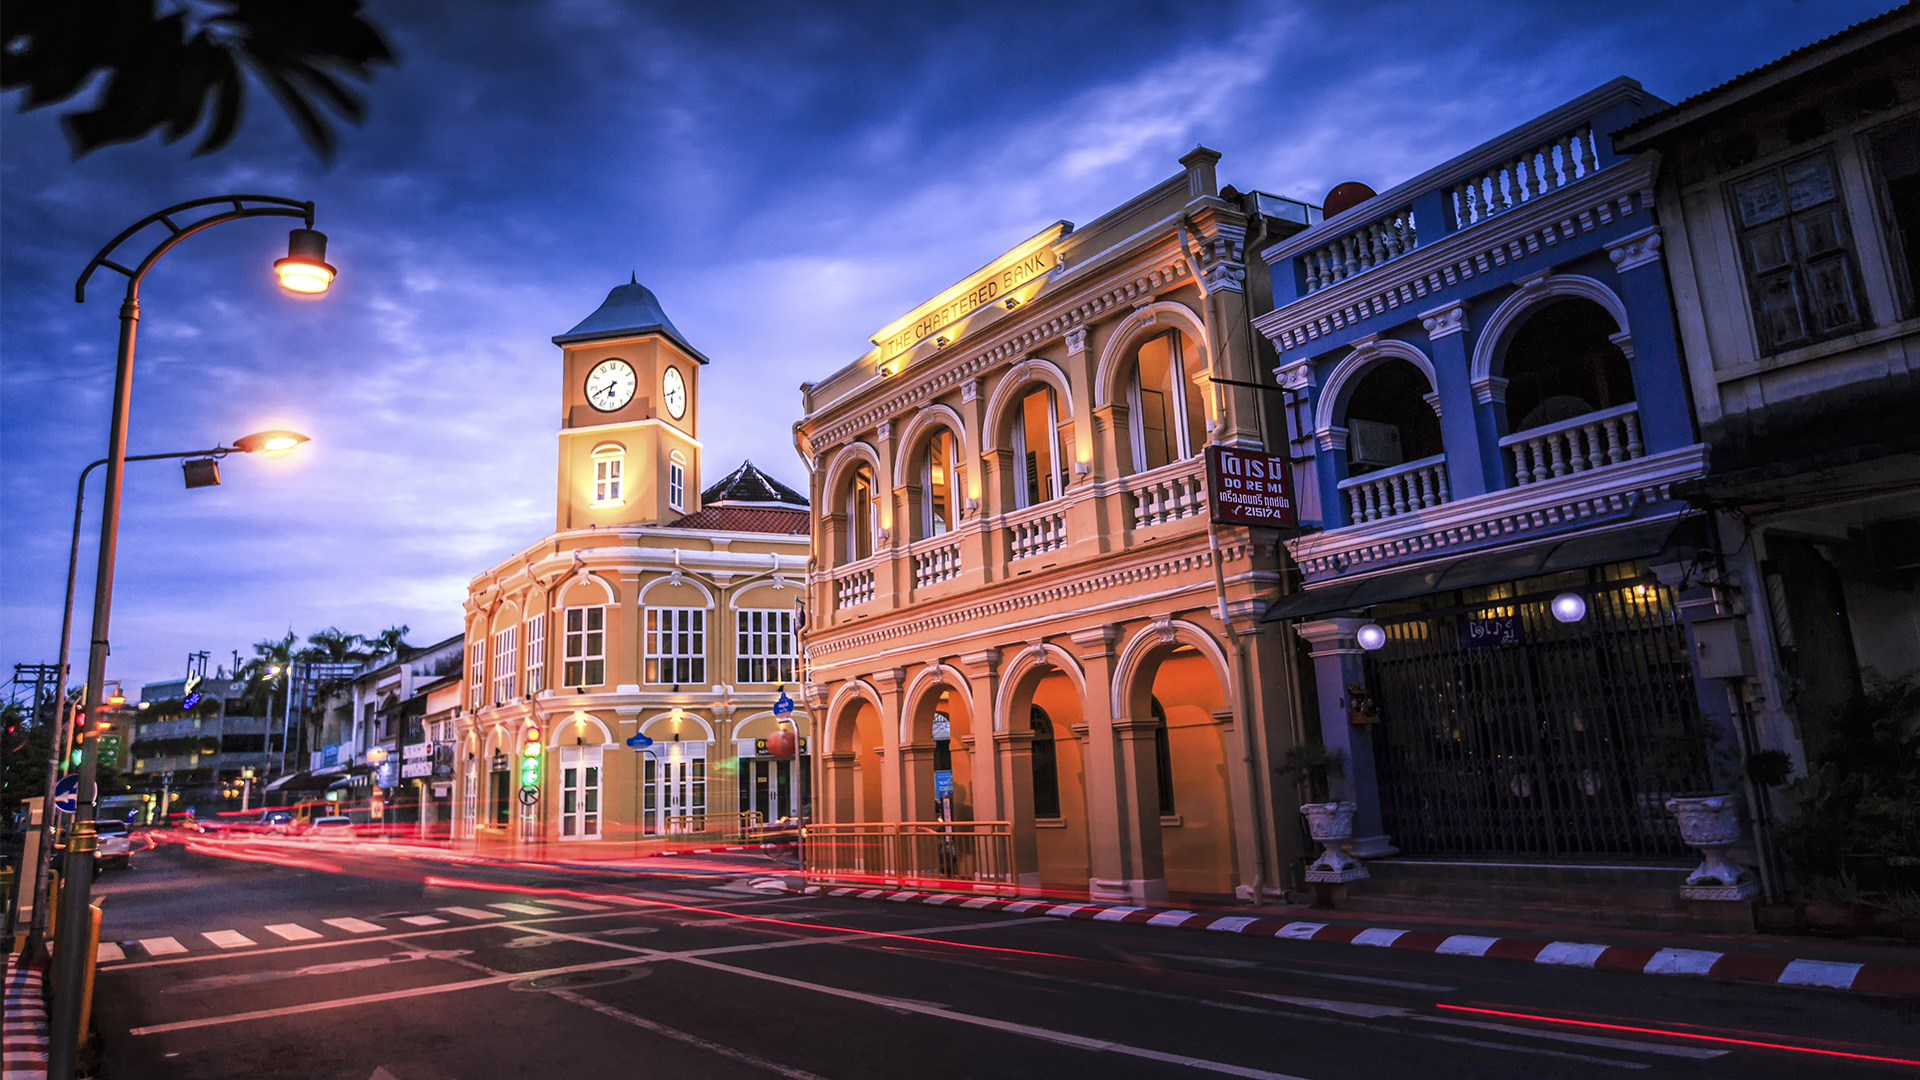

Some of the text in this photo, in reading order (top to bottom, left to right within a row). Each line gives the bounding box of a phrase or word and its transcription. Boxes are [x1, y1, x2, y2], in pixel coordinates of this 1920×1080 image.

[887, 252, 1045, 356] THE CHARTERED BANK
[1224, 477, 1283, 494] DO RE MI
